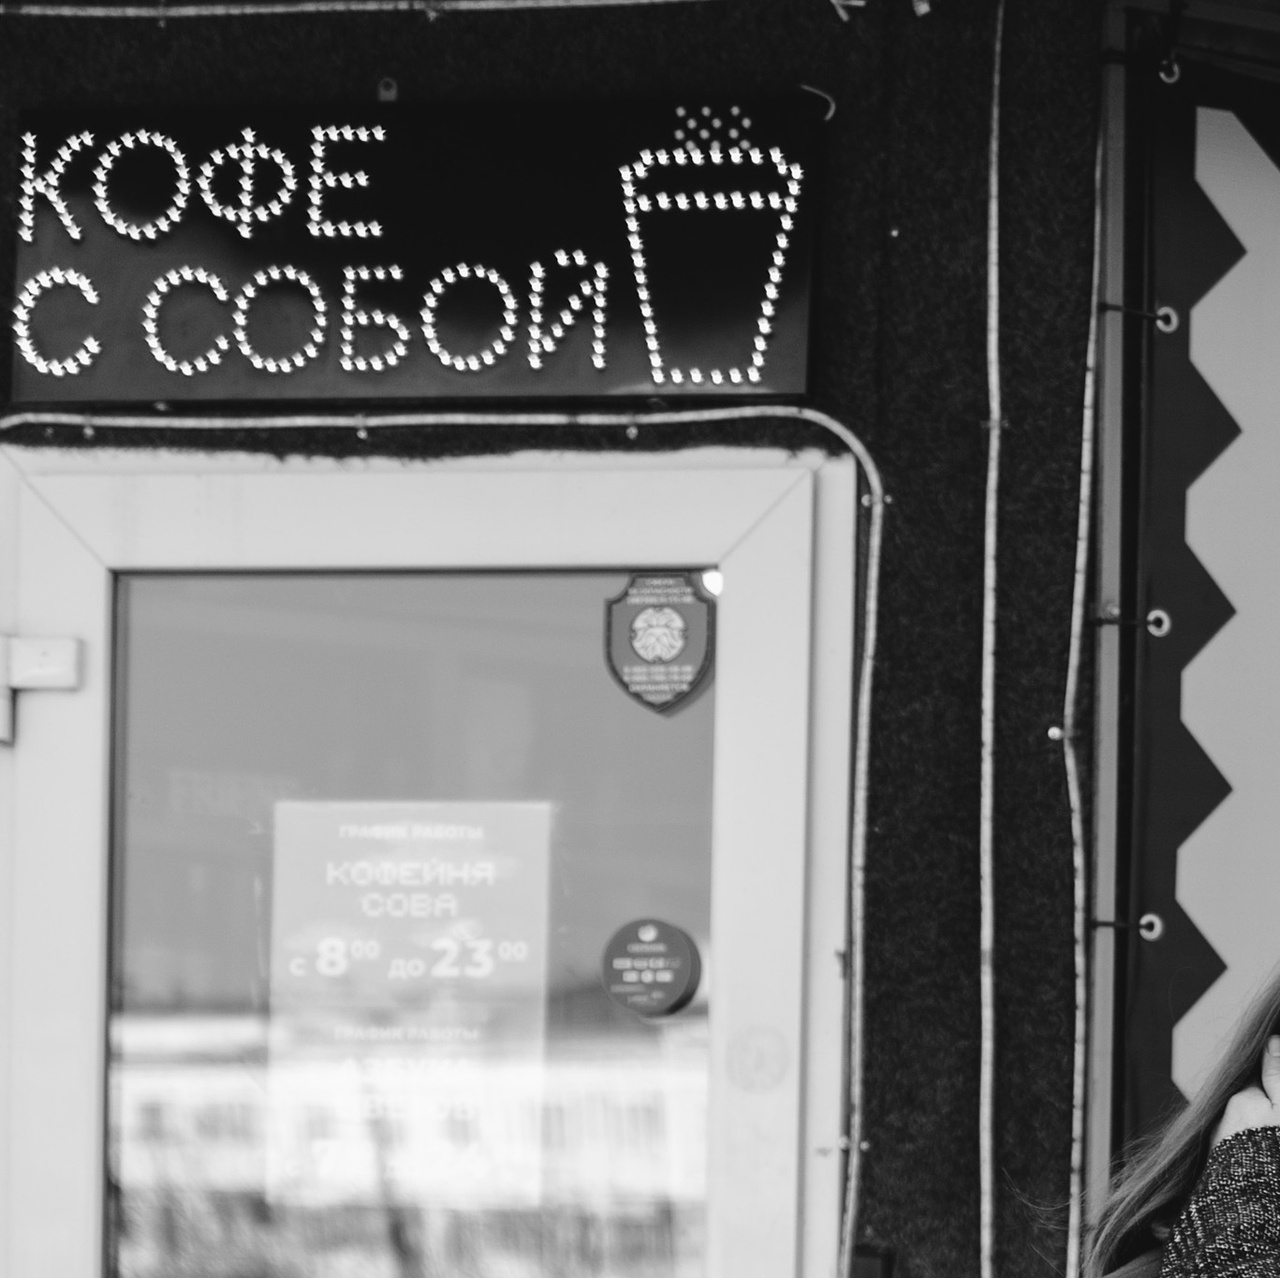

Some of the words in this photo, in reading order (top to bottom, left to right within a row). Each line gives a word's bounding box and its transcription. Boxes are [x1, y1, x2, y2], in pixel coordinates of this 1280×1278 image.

[17, 125, 387, 241] КОФЕ
[13, 266, 102, 376] С
[142, 249, 609, 377] СОБОЙ
[411, 824, 484, 839] РАБОТЫ
[326, 858, 496, 886] КОФЕЙНЯ
[361, 893, 458, 918] СОВА
[387, 957, 426, 980] до
